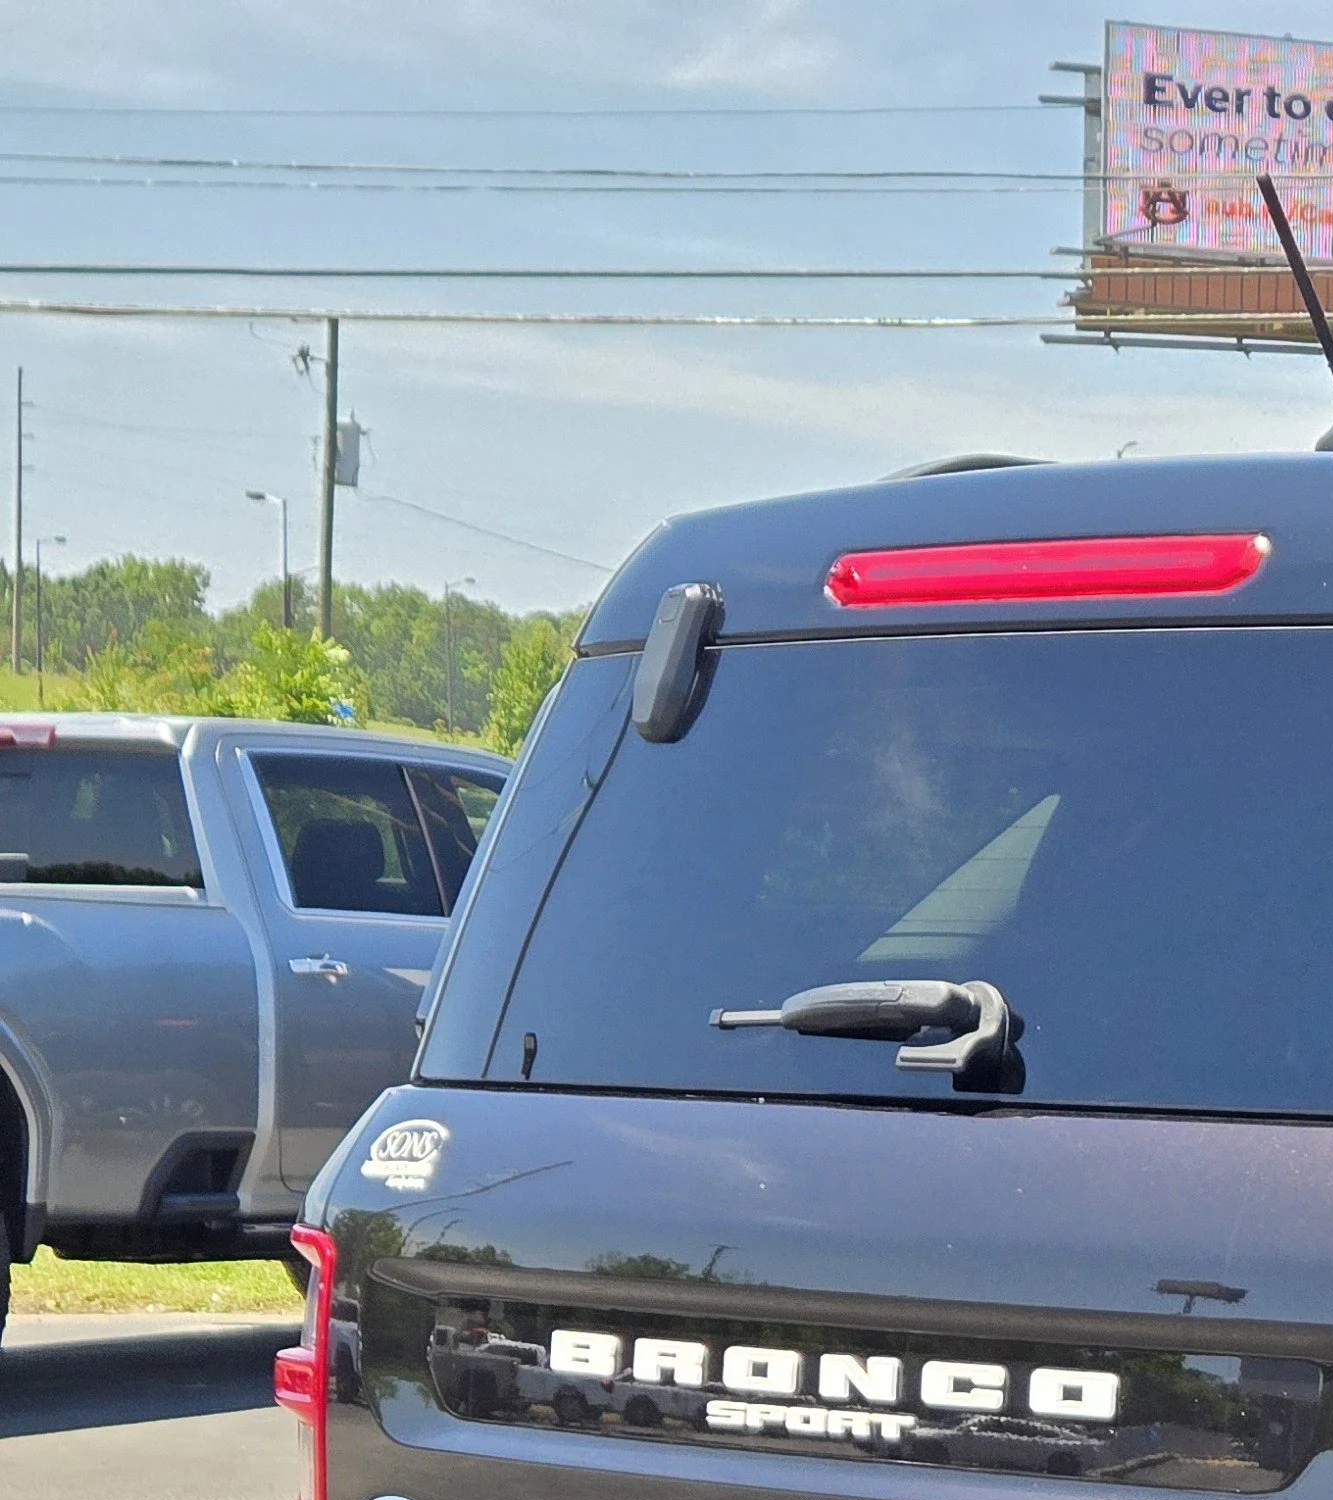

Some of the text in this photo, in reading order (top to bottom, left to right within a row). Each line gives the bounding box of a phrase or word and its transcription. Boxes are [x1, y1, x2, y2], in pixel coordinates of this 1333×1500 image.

[1143, 72, 1250, 115] Ever
[1263, 85, 1312, 120] to
[378, 1130, 438, 1159] SONS
[549, 1329, 1120, 1419] BRONCO
[706, 1399, 915, 1439] SPORT
